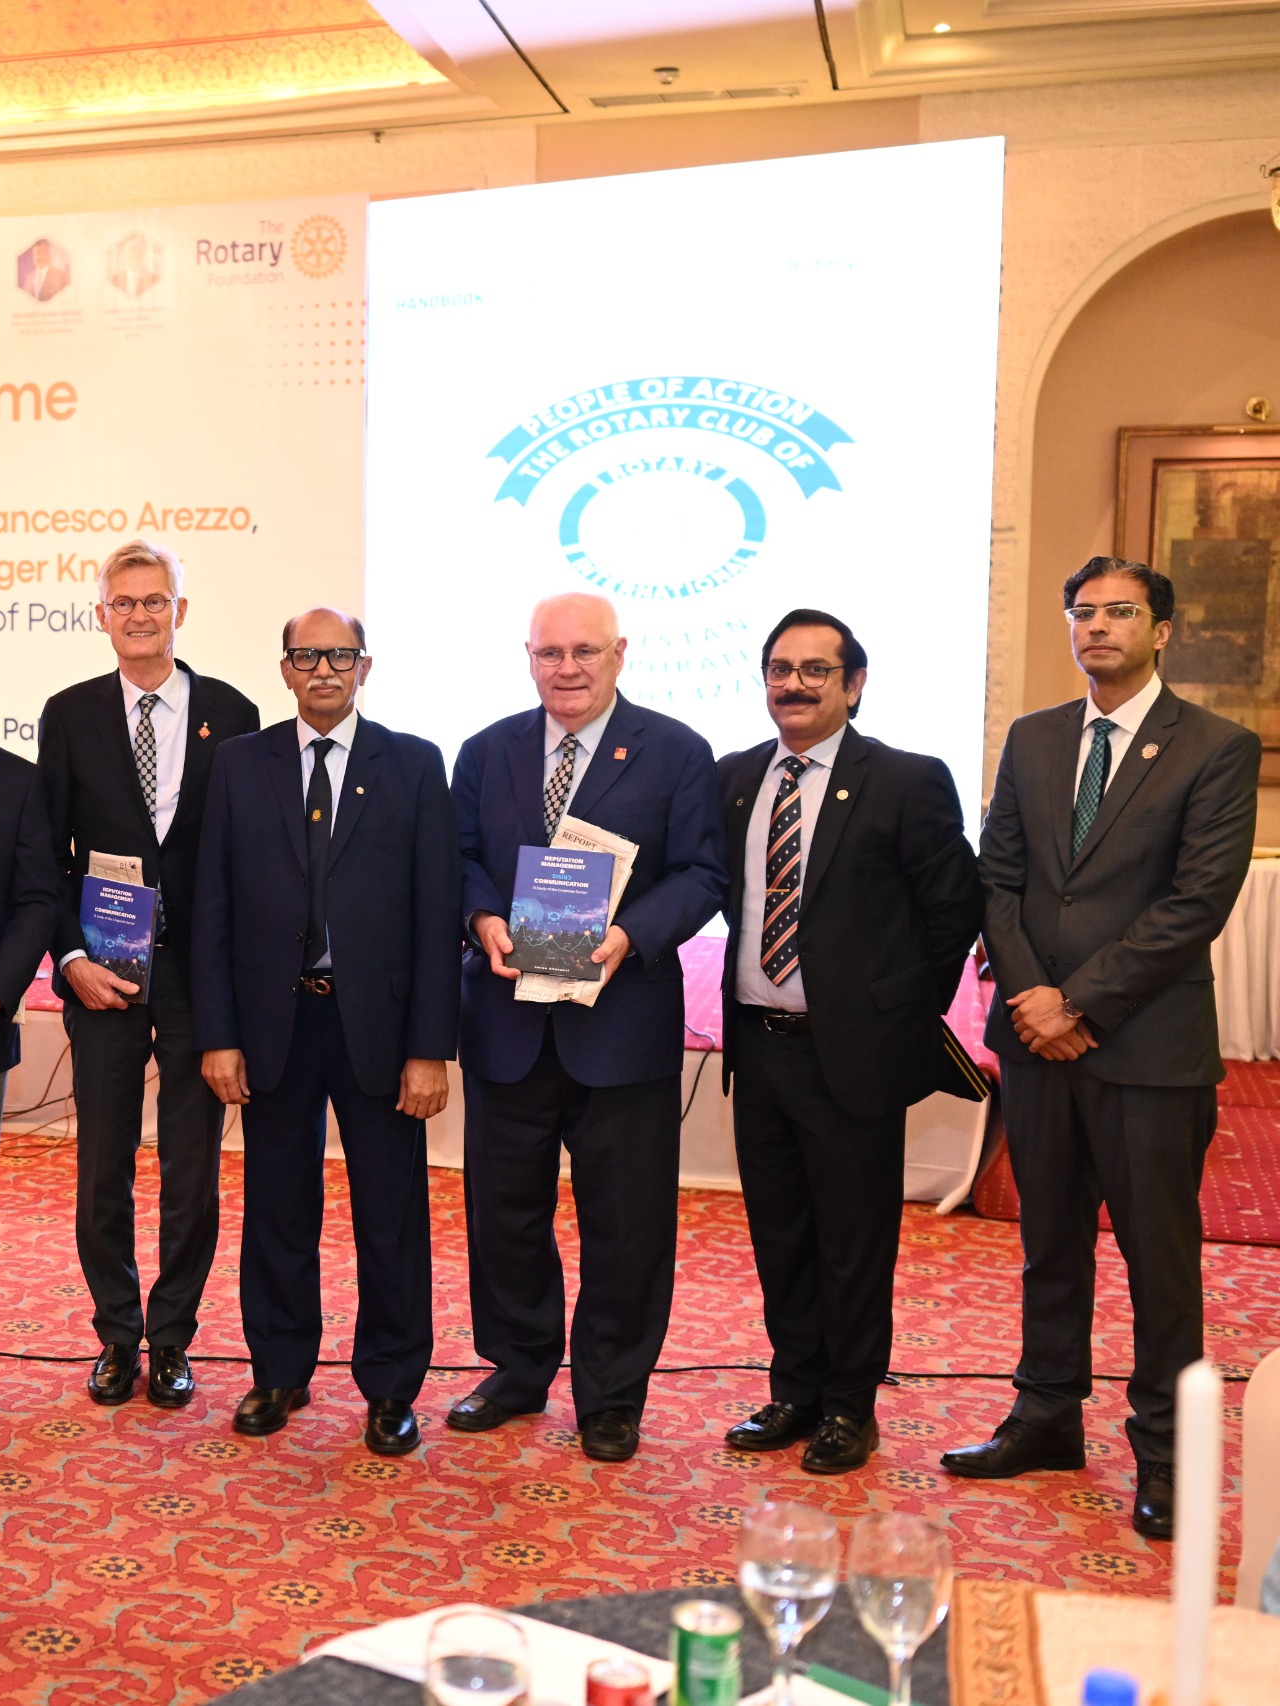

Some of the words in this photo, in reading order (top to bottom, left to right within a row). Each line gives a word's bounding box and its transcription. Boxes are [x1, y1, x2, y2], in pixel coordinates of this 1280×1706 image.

[260, 220, 285, 234] The
[195, 239, 283, 267] Rotary
[207, 271, 285, 286] Foundation
[521, 382, 632, 437] PEOPLE
[639, 378, 685, 399] OF
[690, 380, 816, 426] ACTION
[518, 441, 570, 479] THE
[568, 407, 691, 447] ROTARY
[697, 410, 775, 446] CLUB
[773, 441, 815, 470] OF
[609, 457, 719, 481] ROTARY
[135, 501, 259, 534] Arezzo,
[561, 831, 598, 850] REPORT
[541, 861, 586, 870] MANAGEMENT
[544, 855, 584, 864] REPUTATION
[534, 878, 589, 888] COMMUNICATION
[100, 892, 134, 902] MANAGEMENT
[102, 887, 132, 897] REPUTATION
[94, 907, 136, 920] COMMUNICATION
